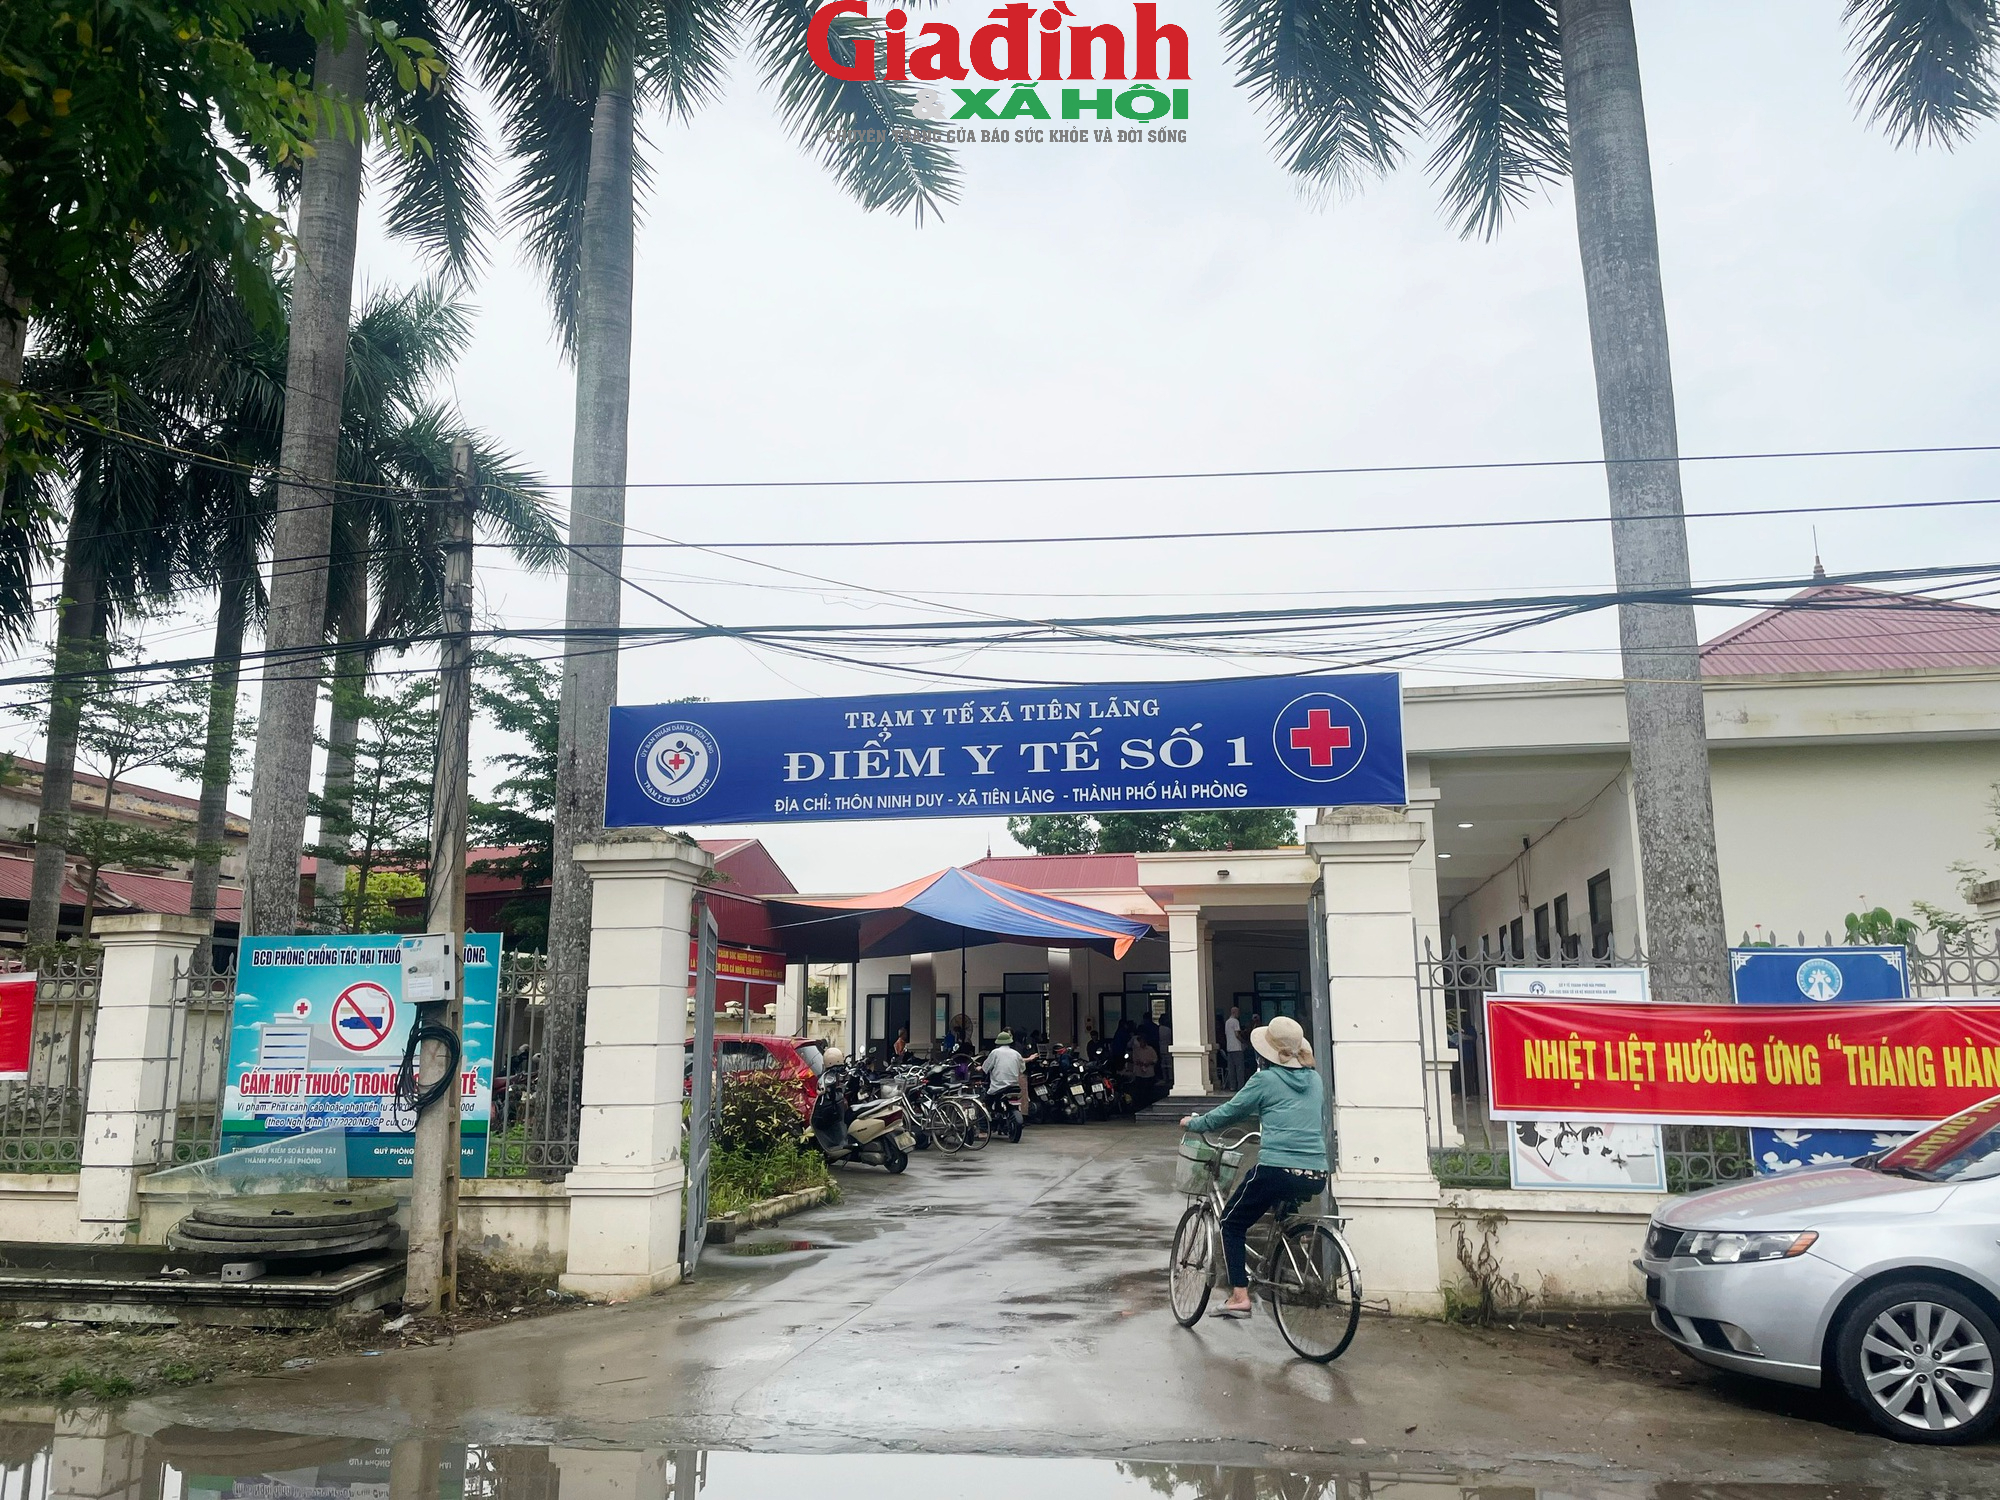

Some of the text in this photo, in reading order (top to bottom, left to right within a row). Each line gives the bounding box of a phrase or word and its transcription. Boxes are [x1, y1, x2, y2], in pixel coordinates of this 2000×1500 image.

[845, 695, 1160, 730] TRẠM Y TẾ XÃ TIÊN LÃNG
[783, 722, 1253, 783] ĐIỂM Y TẾ SỐ 1
[774, 799, 800, 814] ĐỊA
[803, 793, 832, 812] CHỈ:
[835, 794, 873, 810] THÔN
[877, 795, 912, 809] NINH
[915, 794, 944, 807] DUY
[957, 788, 979, 806] XÃ
[983, 787, 1009, 805] TIÊN
[1014, 787, 1055, 804] LÃNG
[1072, 784, 1121, 802] THÀNH
[1126, 781, 1157, 801] PHỐ
[1161, 780, 1187, 799] HẢI
[1191, 782, 1248, 799] PHÒNG
[274, 947, 305, 966] PHÒNG
[307, 944, 338, 965] CHỐNG
[340, 946, 357, 965] TÁC
[359, 949, 375, 967] HẠI
[377, 943, 402, 964] THUỐ
[1523, 1032, 1597, 1090] NHIỆT
[1605, 1033, 1657, 1091] LIỆT
[1666, 1029, 1757, 1085] HƯỞNG
[1764, 1036, 1822, 1086] ỨNG
[240, 1066, 270, 1095] CẤM
[273, 1070, 301, 1095] HÚT
[305, 1066, 350, 1095] THUỐC
[461, 1066, 480, 1095] TẾ
[265, 1118, 285, 1128] (theo
[373, 1146, 474, 1157] QUỸ PHÒNG HẠI
[397, 1156, 413, 1165] CỦA
